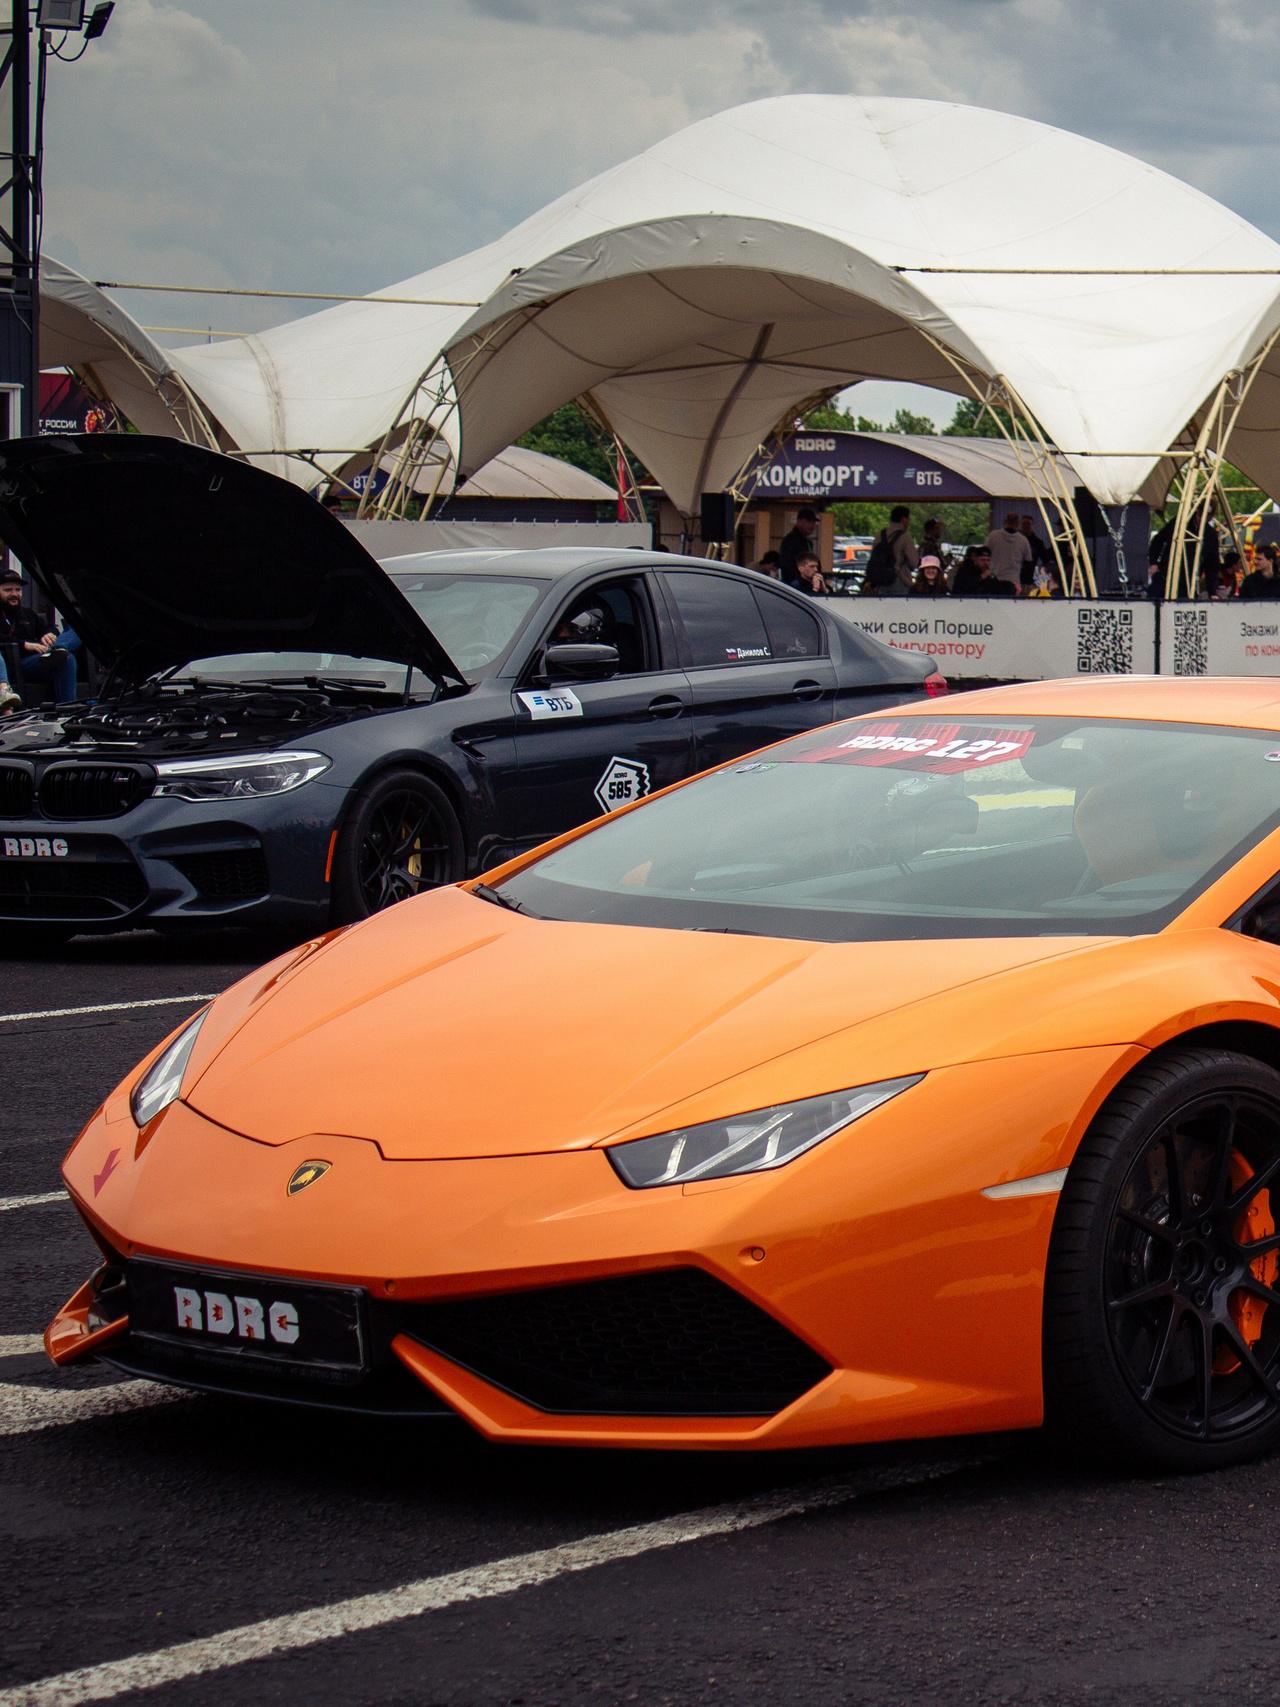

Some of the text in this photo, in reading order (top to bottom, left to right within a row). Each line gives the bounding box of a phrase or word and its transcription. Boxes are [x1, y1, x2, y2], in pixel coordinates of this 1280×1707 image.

[45, 419, 77, 429] РОССИИ
[795, 438, 836, 451] RDRC
[916, 471, 943, 486] ВТБ
[788, 486, 831, 496] СТАНДАРТ
[889, 619, 929, 634] свой
[934, 619, 994, 638] Порше
[1240, 621, 1279, 637] Закажи
[1245, 645, 1259, 657] по
[545, 696, 574, 712] ВТБ
[838, 735, 1024, 762] RDRC 127
[608, 780, 632, 800] 585
[4, 838, 69, 856] RDRC
[173, 1286, 300, 1345] RDRC
